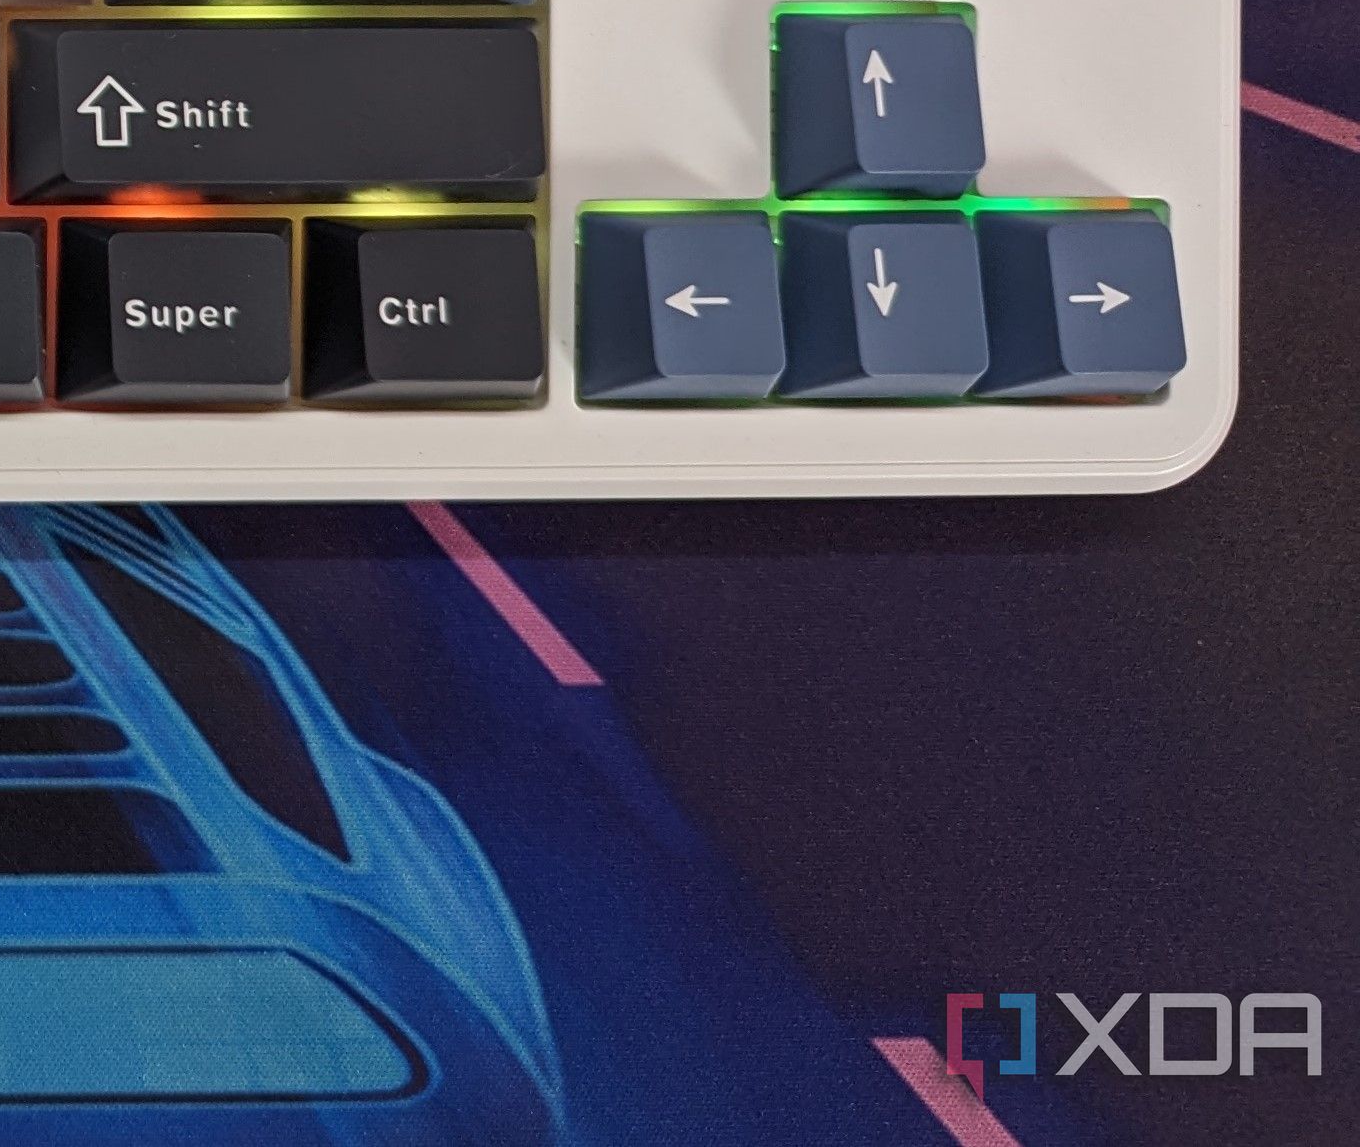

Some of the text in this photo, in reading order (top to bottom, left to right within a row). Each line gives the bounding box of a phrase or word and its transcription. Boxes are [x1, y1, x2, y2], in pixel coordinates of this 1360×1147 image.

[157, 100, 248, 128] Shift
[126, 300, 236, 332] Super
[379, 297, 446, 325] Ctrl
